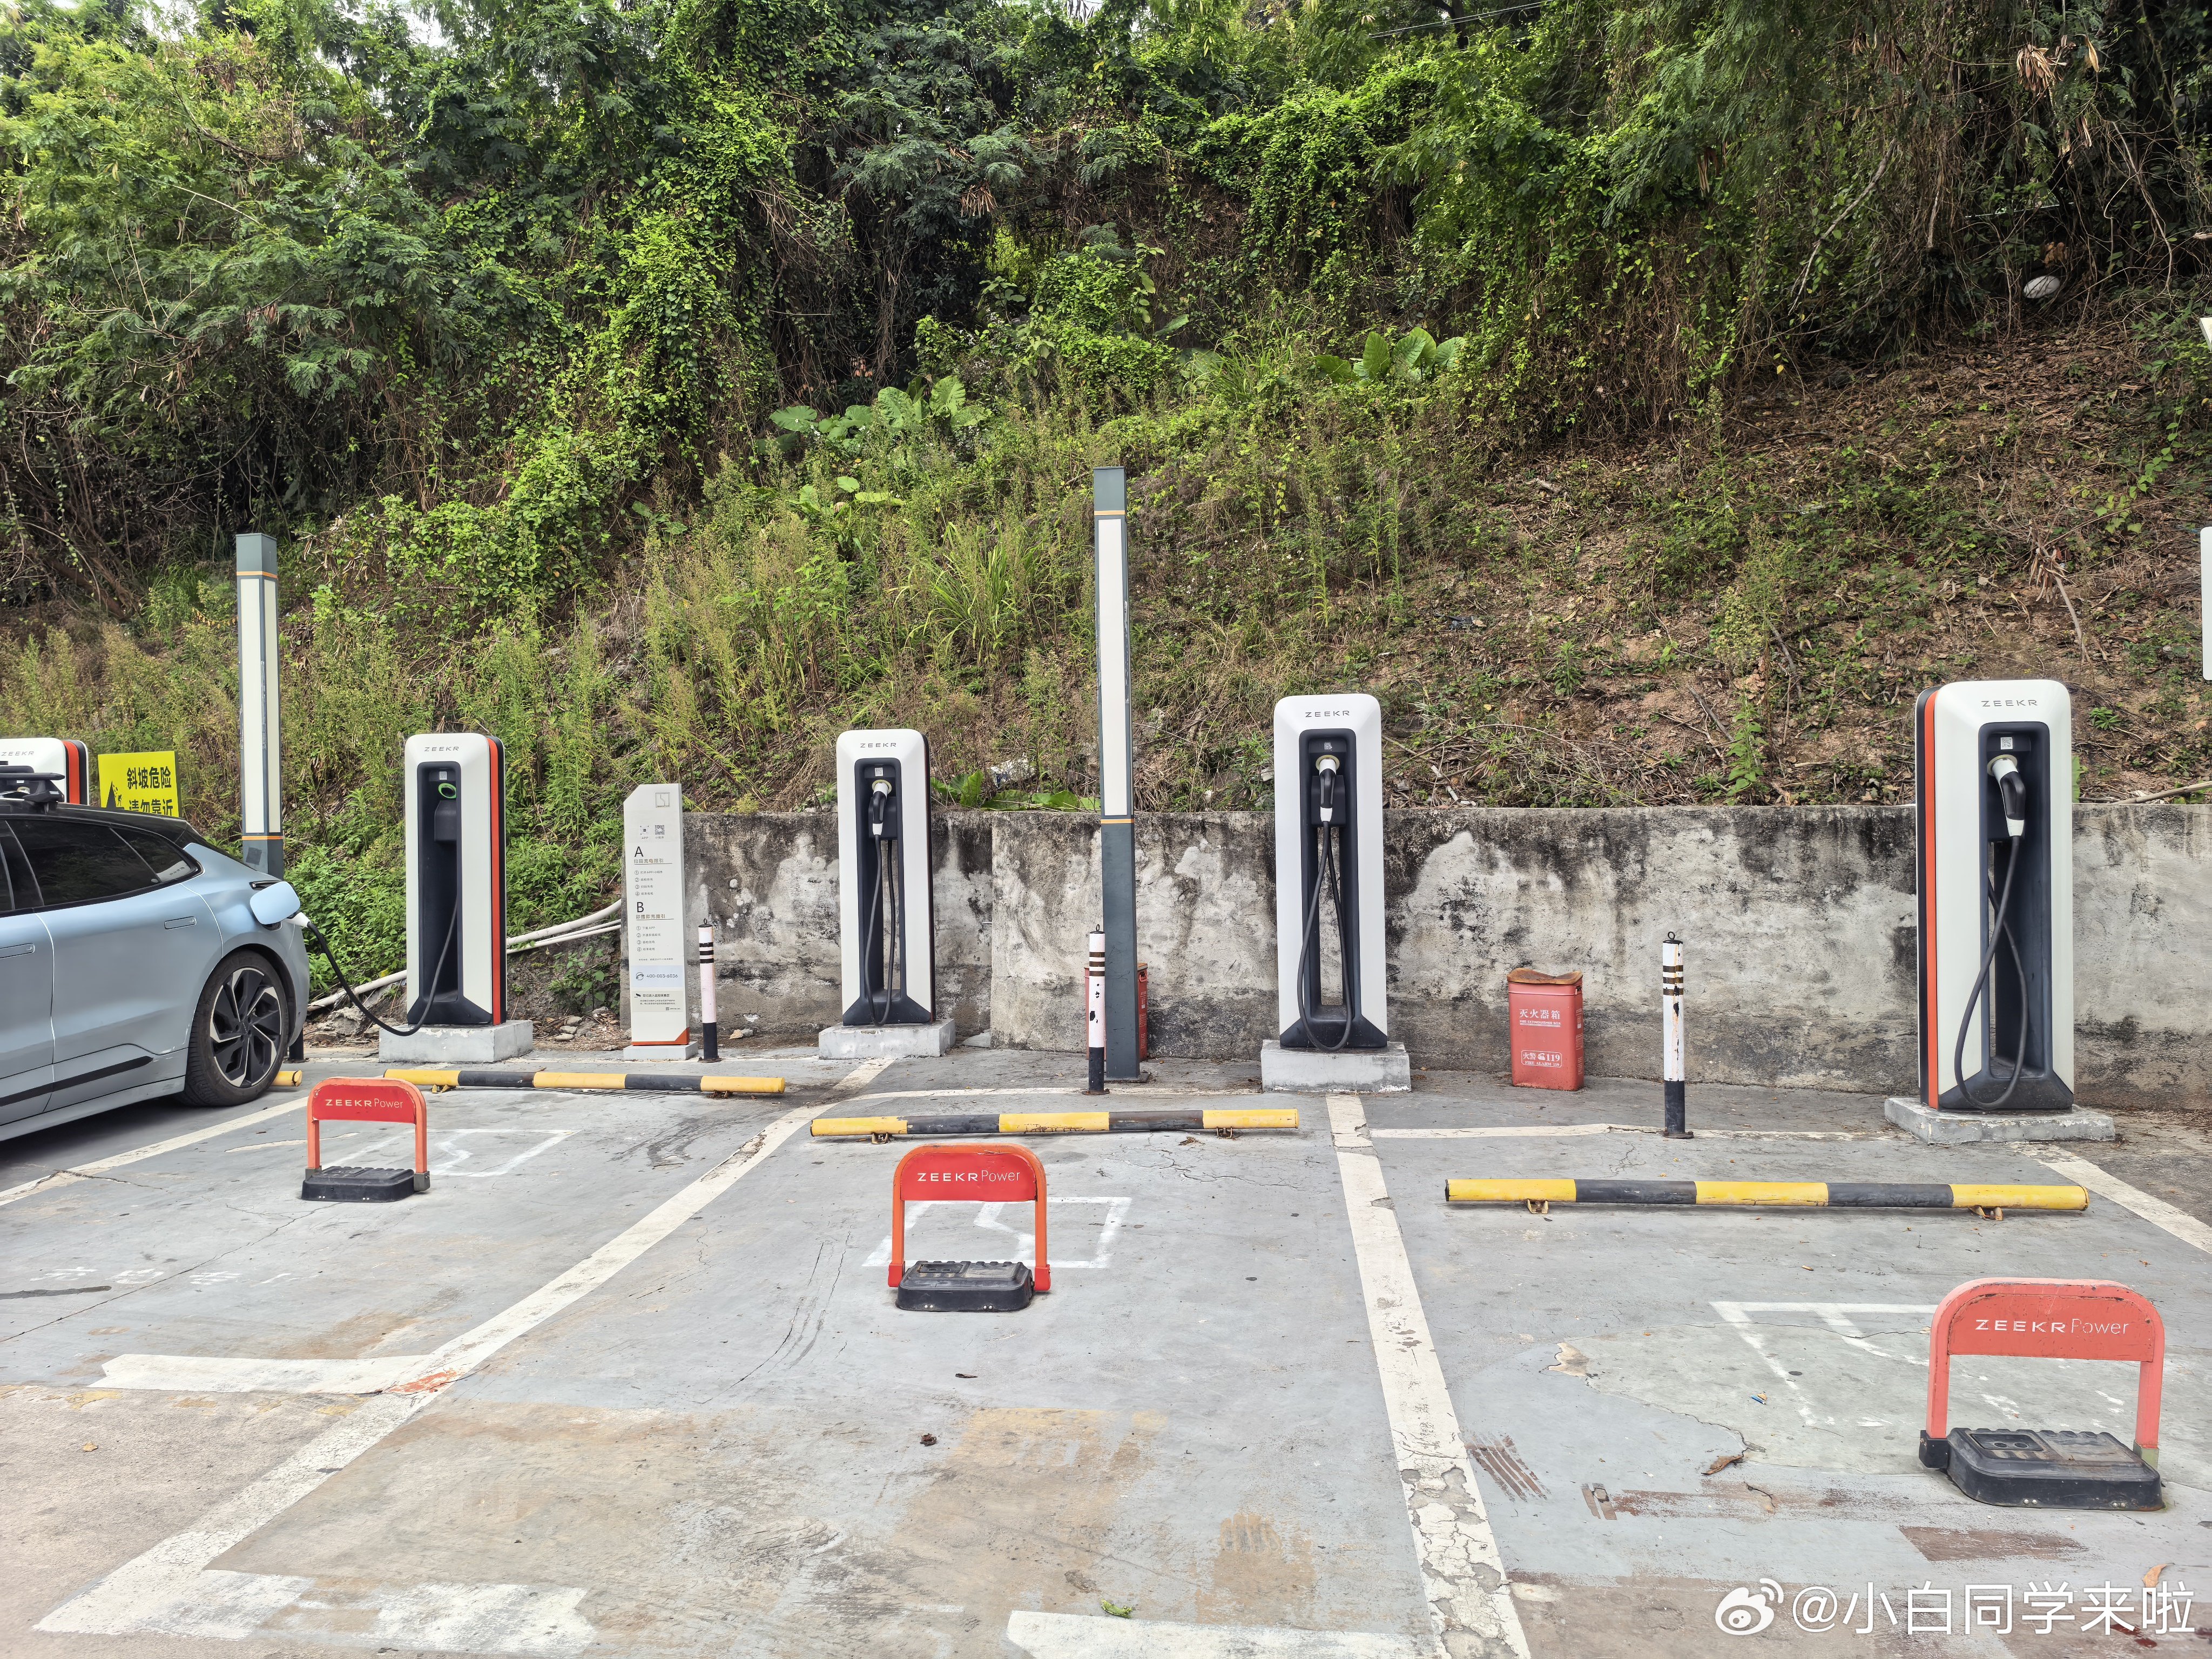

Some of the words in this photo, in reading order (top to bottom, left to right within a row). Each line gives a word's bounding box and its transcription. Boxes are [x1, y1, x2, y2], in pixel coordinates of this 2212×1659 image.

[126, 766, 172, 790] 斜坡危险
[634, 846, 644, 858] A
[637, 901, 644, 913] B
[1519, 1009, 1560, 1020] 灭火器箱
[1523, 1052, 1536, 1060] 火警
[1546, 1054, 1560, 1062] 119
[325, 1098, 373, 1107] ZEEKR
[374, 1098, 403, 1109] Power
[917, 1172, 978, 1182] ZEEKR
[981, 1169, 1021, 1182] Power
[1974, 1319, 2066, 1333] ZEEKR
[2071, 1318, 2129, 1336] Power
